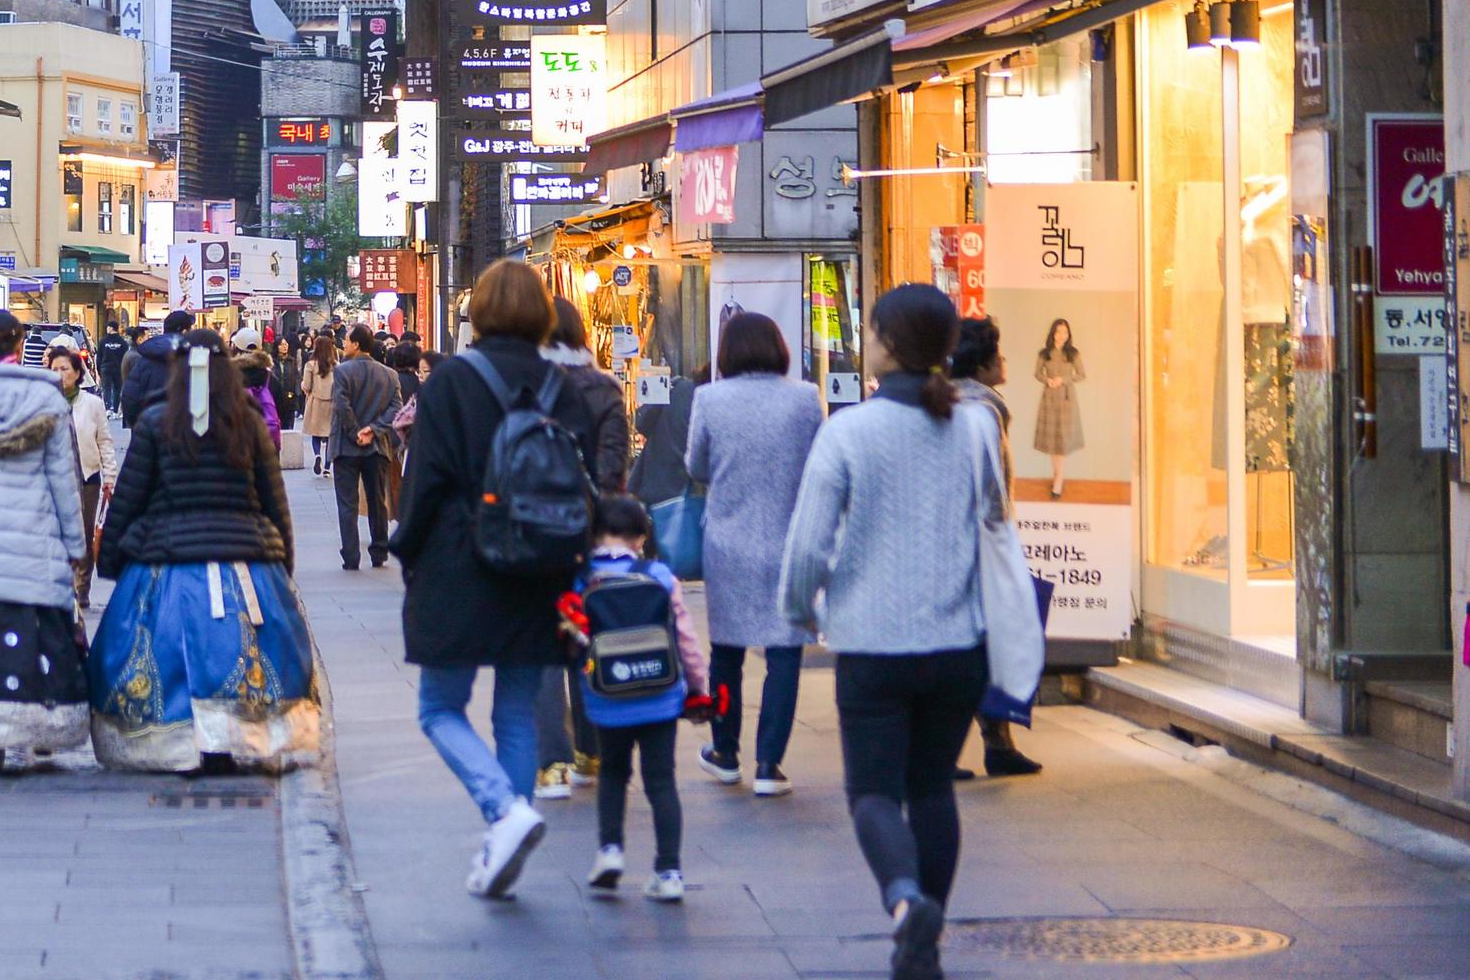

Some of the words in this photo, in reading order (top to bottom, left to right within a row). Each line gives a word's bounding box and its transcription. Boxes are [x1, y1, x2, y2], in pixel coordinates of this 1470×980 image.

[463, 48, 498, 60] 4,5,6F
[540, 51, 583, 72] 도도
[367, 38, 389, 113] 수제도장
[279, 123, 314, 143] 국내
[1402, 147, 1444, 164] Galle
[1394, 268, 1444, 285] Yehya
[1029, 567, 1102, 586] 1-1849
